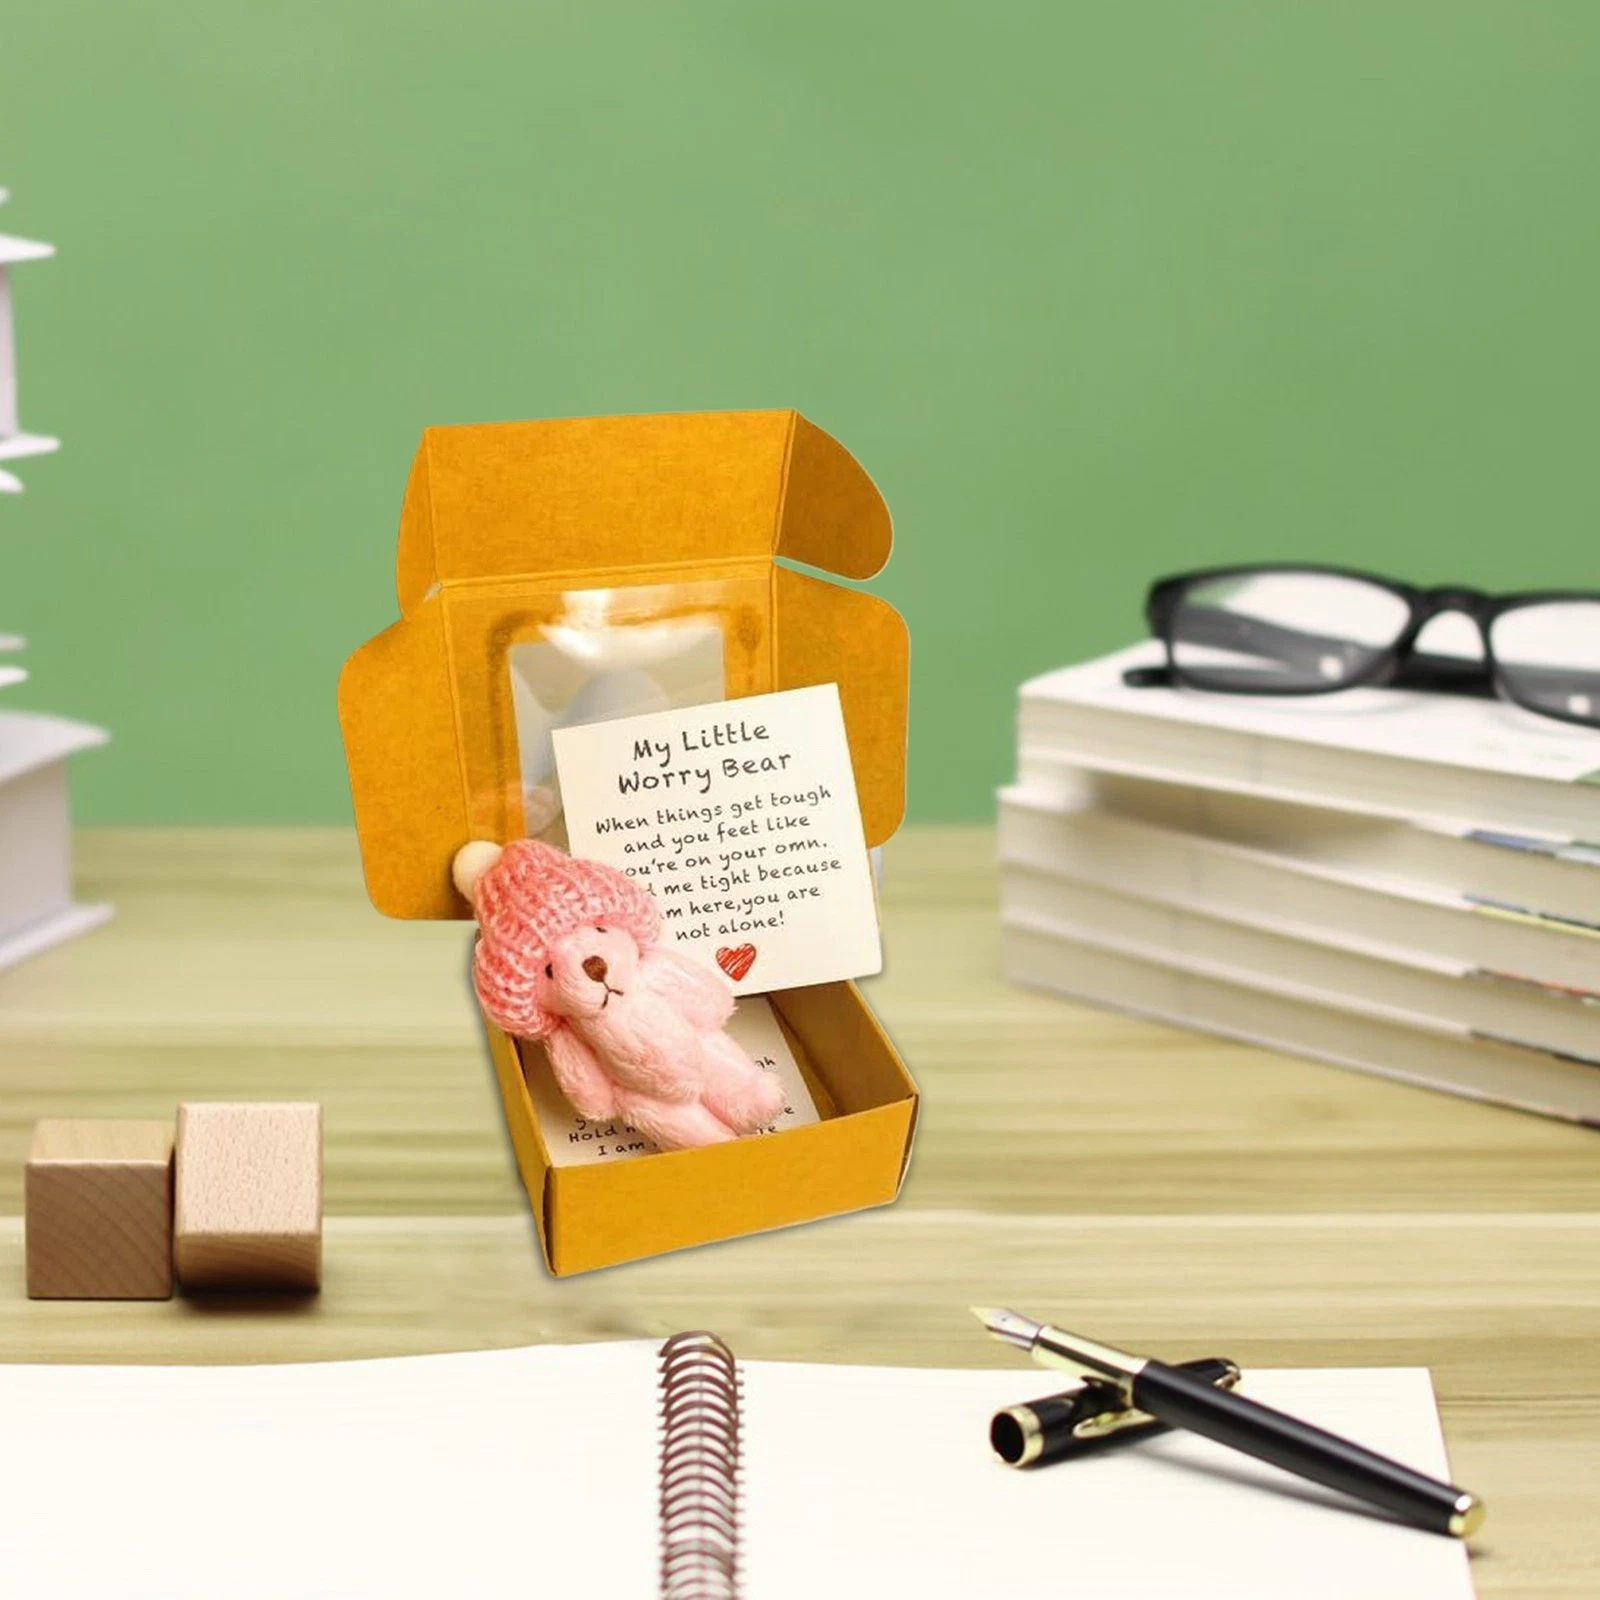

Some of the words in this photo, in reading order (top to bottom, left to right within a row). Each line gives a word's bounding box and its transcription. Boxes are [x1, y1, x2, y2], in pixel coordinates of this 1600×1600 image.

[633, 739, 671, 767] My
[682, 721, 769, 752] Little
[618, 768, 711, 794] Worry
[722, 752, 791, 778] Bear
[596, 817, 649, 835] When
[657, 805, 723, 823] things
[730, 795, 763, 818] get
[771, 785, 831, 807] tough
[624, 835, 665, 854] and
[671, 832, 711, 854] you
[621, 859, 678, 877] ou're
[685, 855, 711, 868] on
[719, 846, 766, 870] your
[664, 881, 694, 895] me
[701, 870, 751, 892] tight
[759, 857, 842, 881] because
[787, 885, 821, 900] are
[676, 922, 711, 941] not
[718, 910, 785, 936] alone!
[598, 1146, 607, 1156] I
[616, 1141, 645, 1153] am
